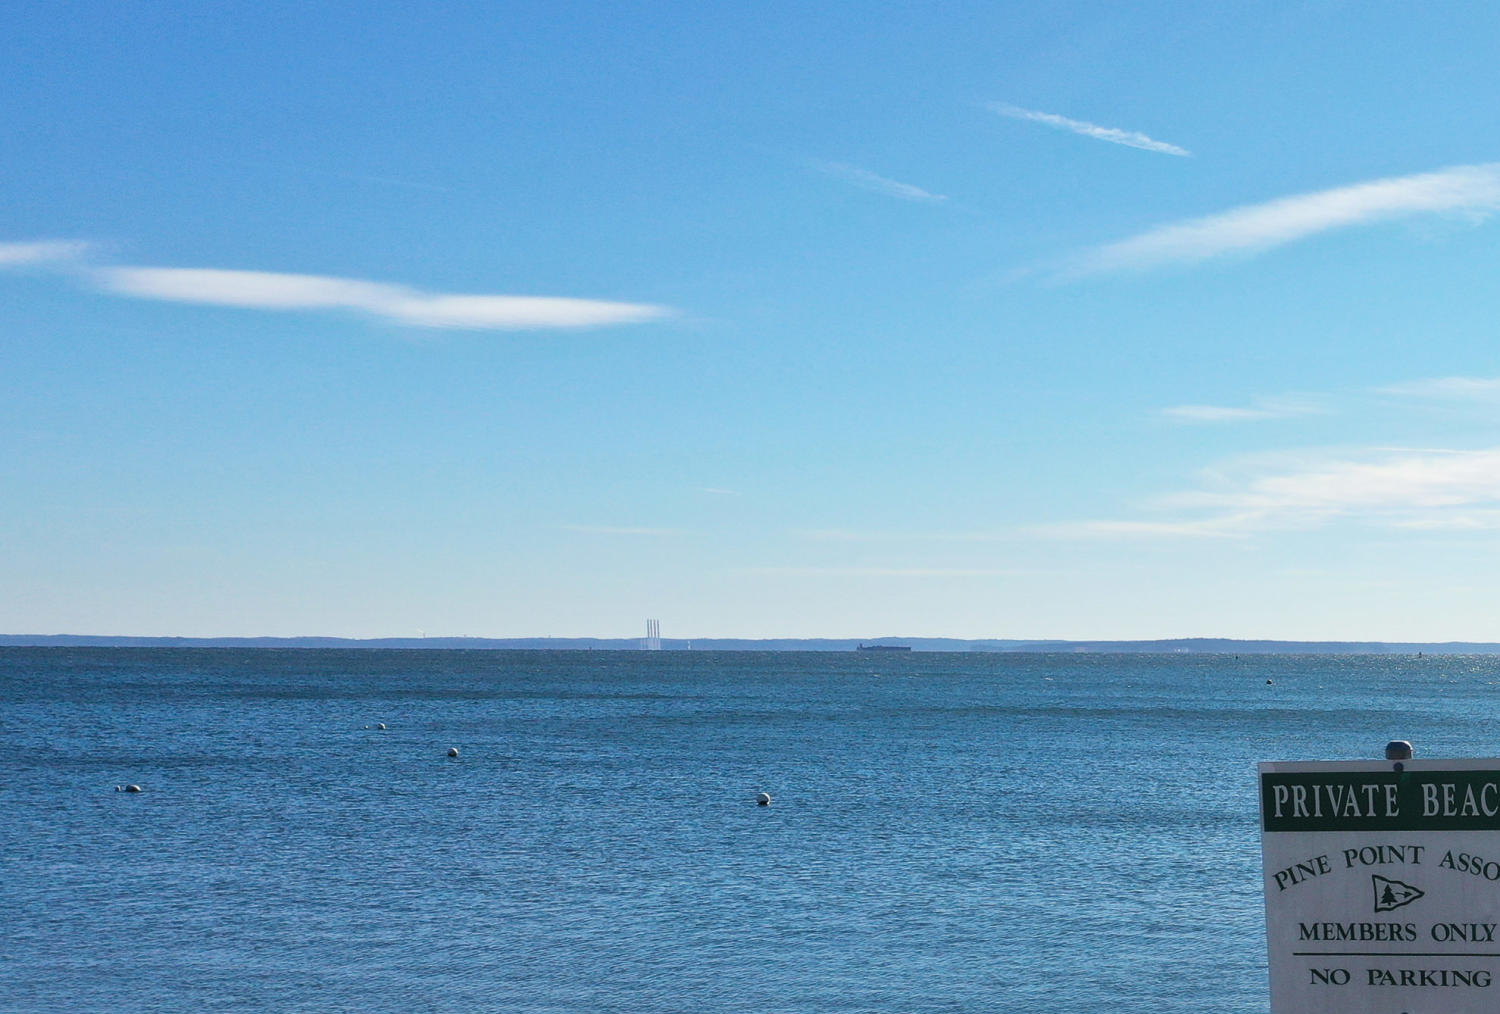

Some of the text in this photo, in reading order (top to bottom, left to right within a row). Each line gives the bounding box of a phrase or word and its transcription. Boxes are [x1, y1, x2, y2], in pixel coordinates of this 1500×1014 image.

[1272, 784, 1400, 818] PRIVATE
[1272, 855, 1332, 892] PINE
[1343, 845, 1425, 868] POINT
[1298, 922, 1498, 942] MEMBERS ONLY
[1309, 968, 1492, 988] NO PARKING
